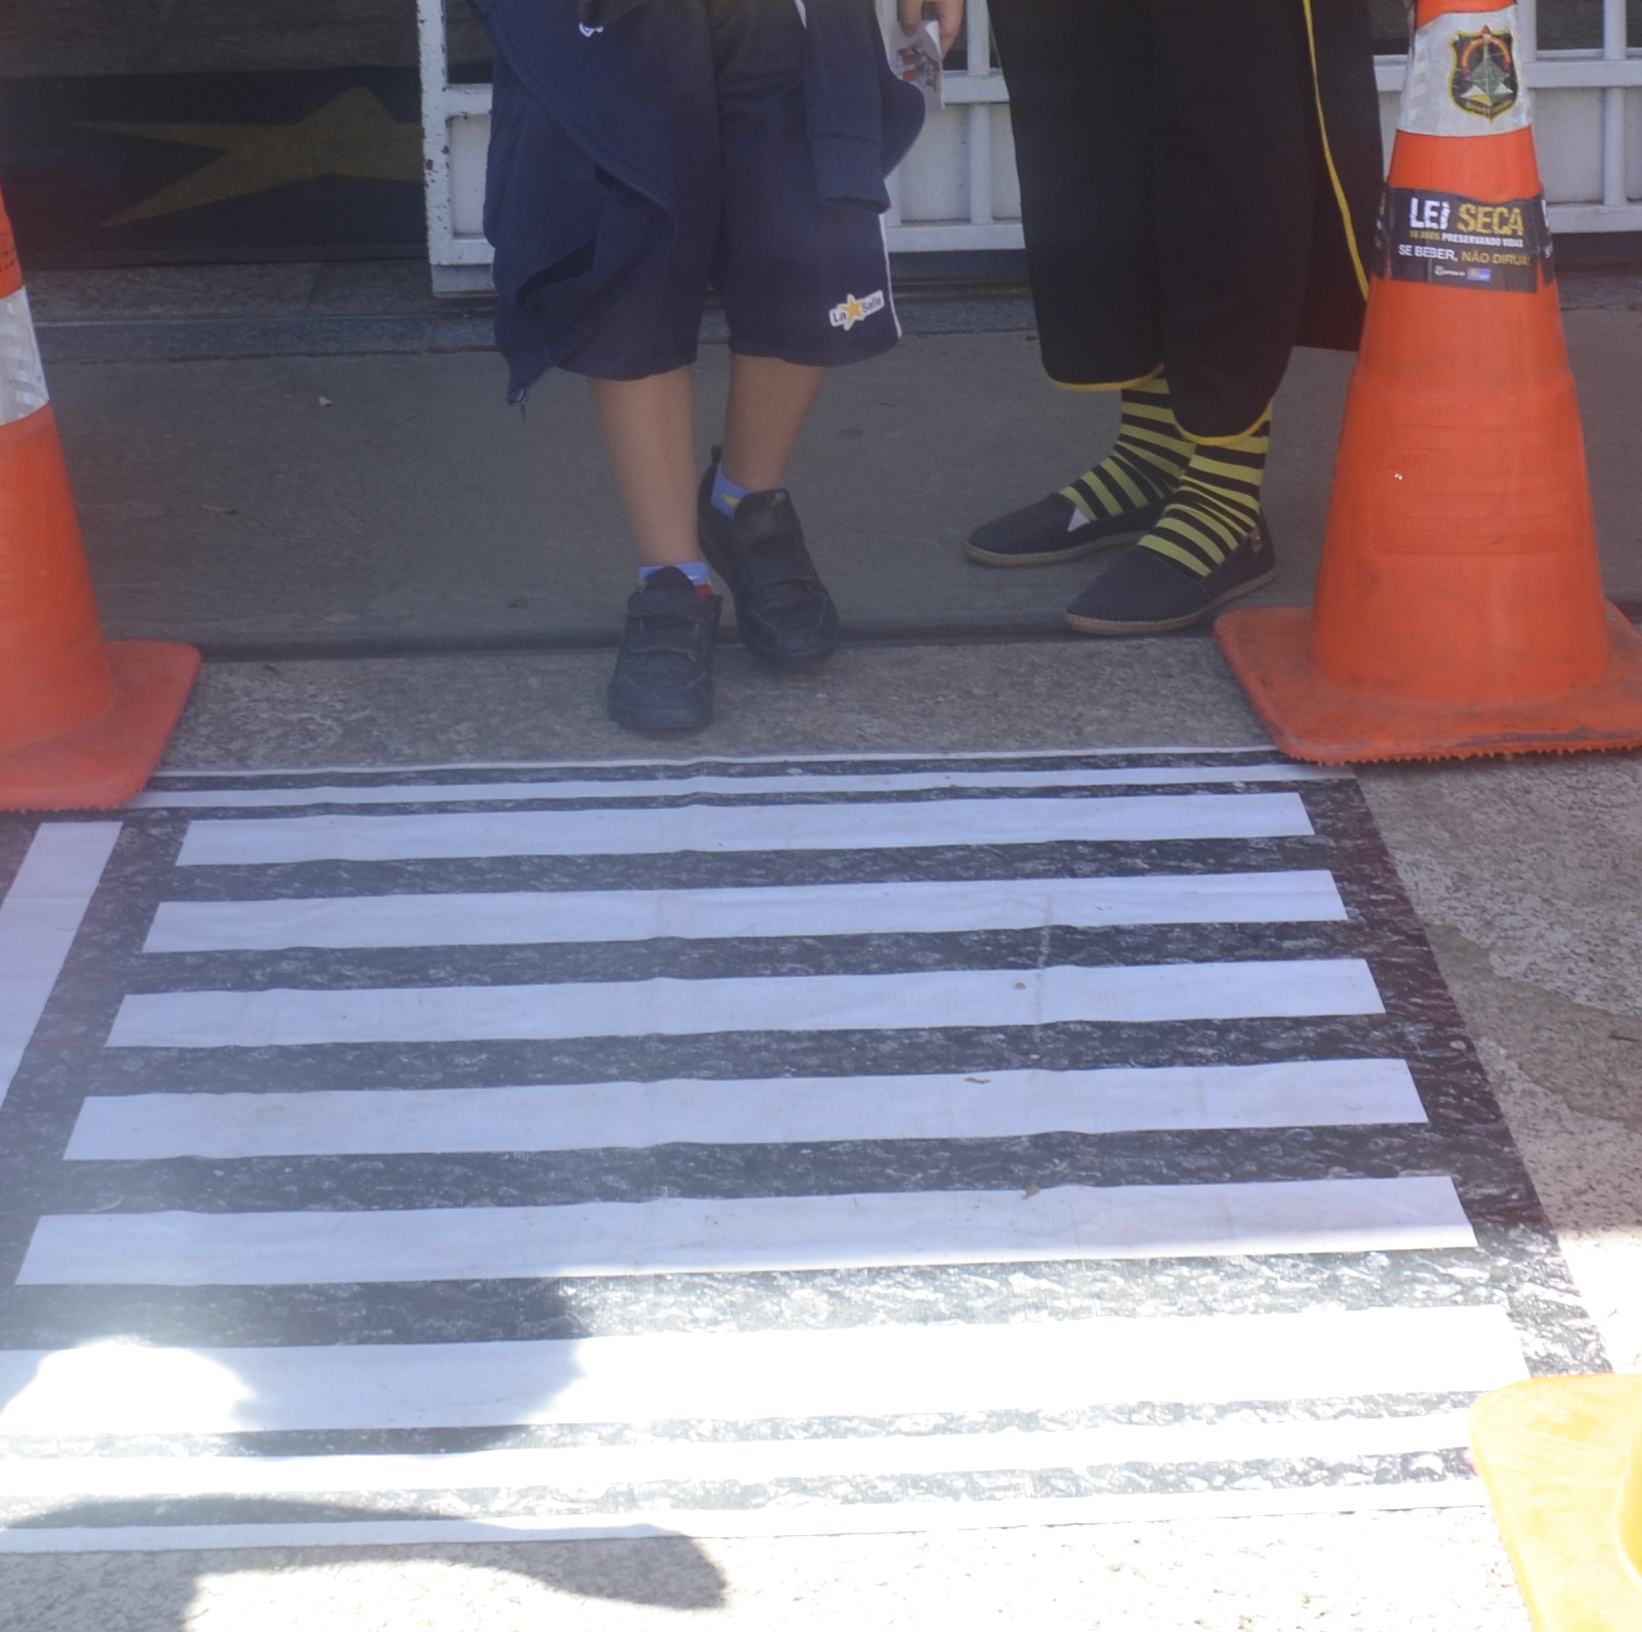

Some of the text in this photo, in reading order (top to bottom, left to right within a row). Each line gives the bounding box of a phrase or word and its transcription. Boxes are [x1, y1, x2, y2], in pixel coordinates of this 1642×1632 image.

[1409, 197, 1451, 230] LEI
[1457, 203, 1525, 236] SECA
[1441, 232, 1502, 247] PRESERVANDO
[1398, 244, 1413, 257] SE
[1414, 245, 1458, 262] BEBER,
[1461, 249, 1490, 264] NÃO
